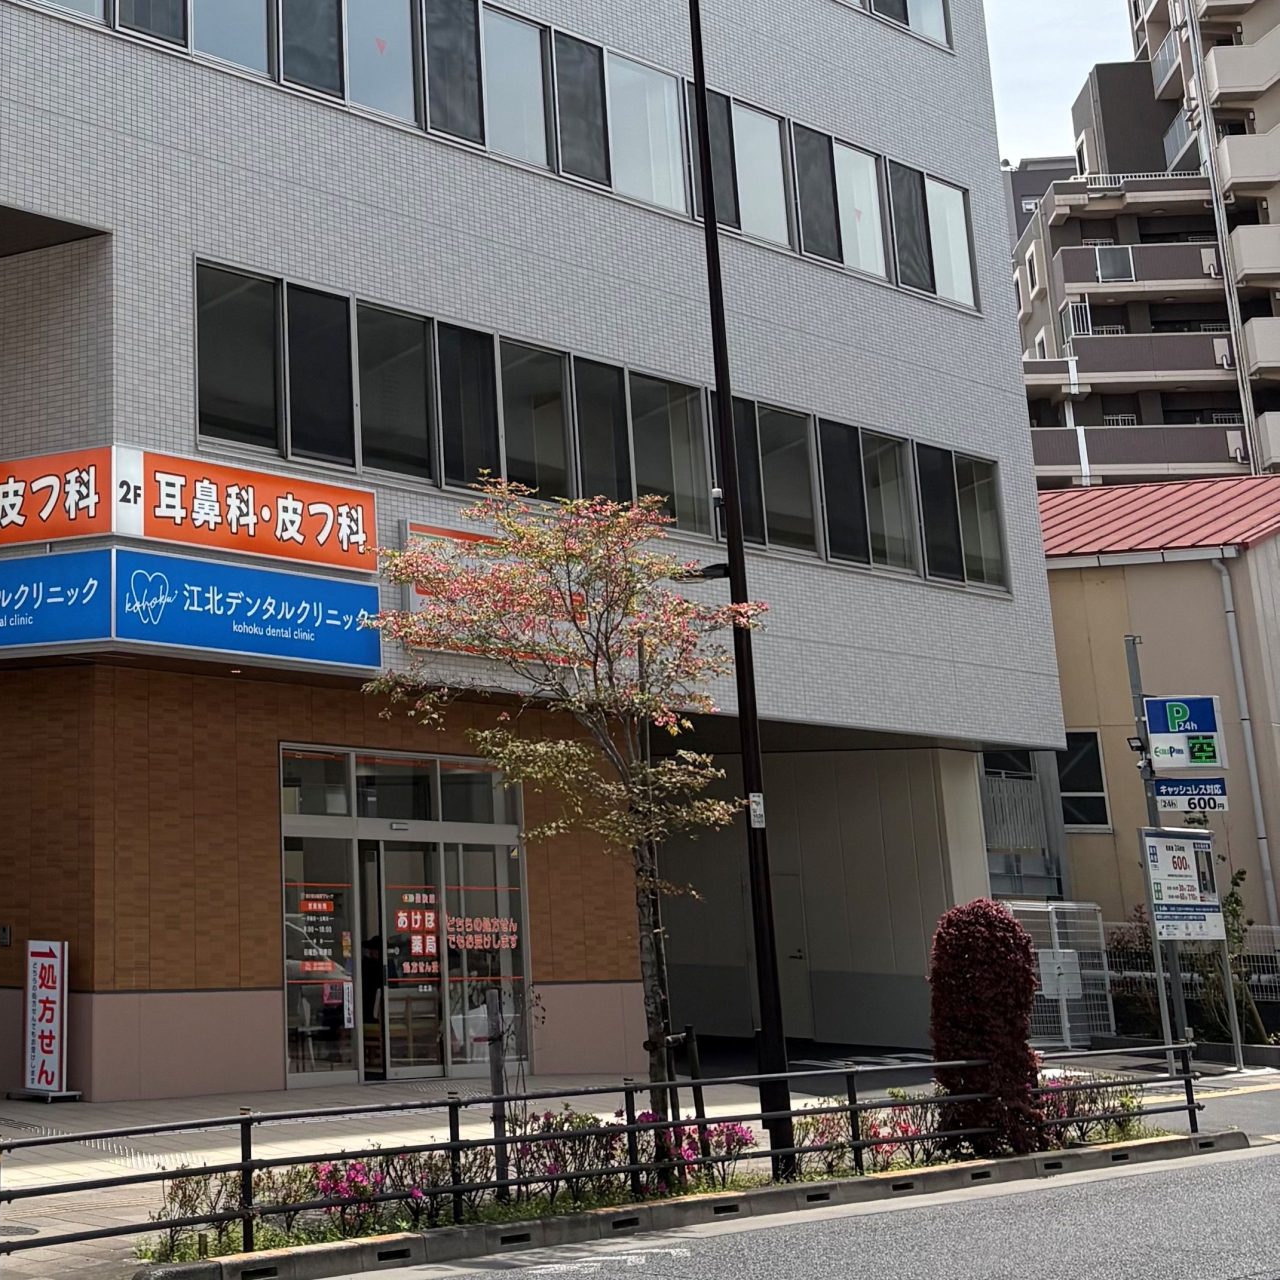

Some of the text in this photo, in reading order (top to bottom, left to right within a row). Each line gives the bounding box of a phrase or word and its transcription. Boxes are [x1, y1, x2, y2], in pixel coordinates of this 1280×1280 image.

[118, 479, 142, 505] 2F
[153, 470, 368, 554] 耳鼻科・皮フ科
[182, 583, 370, 632] 江北デンタルクリニック
[9, 614, 34, 626] clinic
[232, 621, 315, 641] kohoku dental clinic
[1165, 702, 1197, 732] P 24h
[1160, 784, 1222, 795] キャッシュレス対応
[1187, 797, 1225, 810] 600円
[411, 935, 437, 954] 薬局
[37, 962, 57, 1086] 処方せん
